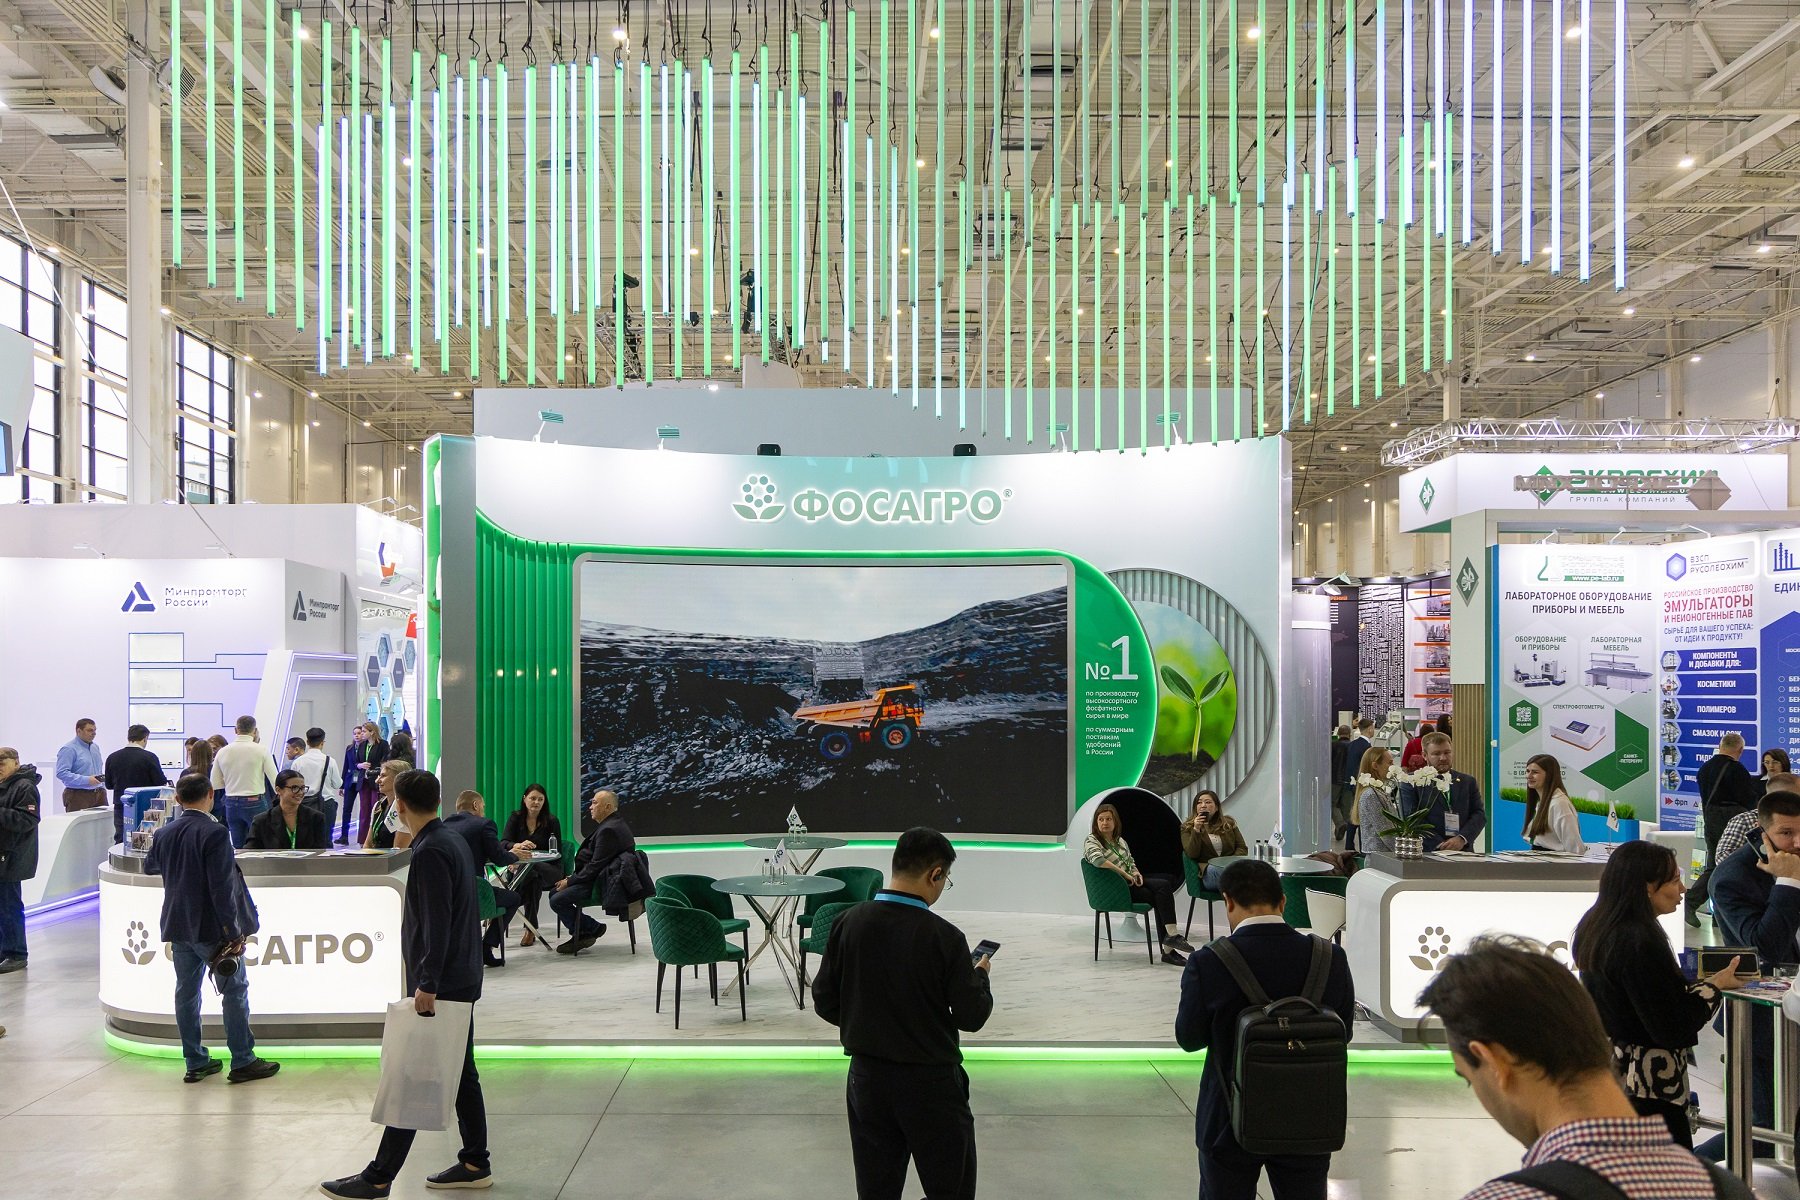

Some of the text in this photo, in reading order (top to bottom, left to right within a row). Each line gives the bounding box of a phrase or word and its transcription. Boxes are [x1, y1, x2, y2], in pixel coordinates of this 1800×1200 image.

[165, 587, 247, 597] Минпромторг
[1664, 584, 1754, 598] РОССИЙСКОЕ ПРОИЗВОДСТВО
[1505, 591, 1652, 602] ЛАБОРАТОРНОЕ ОБОРУДОВАНИЕ
[165, 598, 209, 607] России
[309, 598, 340, 611] Минпромторг
[1664, 594, 1753, 613] ЭМУЛЬГАТОРЫ
[309, 608, 327, 619] России
[1532, 605, 1625, 614] ПРИБОРЫ И МЕБЕЛЬ
[1664, 609, 1753, 623] И НЕИОНОГЕННЫЕ ПАВ
[1664, 626, 1684, 635] СЫРЬЕ
[1685, 625, 1698, 634] ДЛЯ
[1699, 624, 1725, 633] ВАШЕГО
[1514, 635, 1567, 643] ОБОРУДОВАНИЕ
[1684, 635, 1700, 643] ИДЕИ
[1701, 634, 1706, 642] К
[1707, 633, 1743, 642] ПРОДУКТУ!
[1692, 651, 1738, 660] КОМПОНЕНТЫ
[1695, 660, 1724, 669] ДОБАВКИ
[1697, 680, 1736, 688] КОСМЕТИКИ
[1696, 705, 1737, 713] ПОЛИМЕРОВ
[1692, 729, 1719, 737] СМАЗОК
